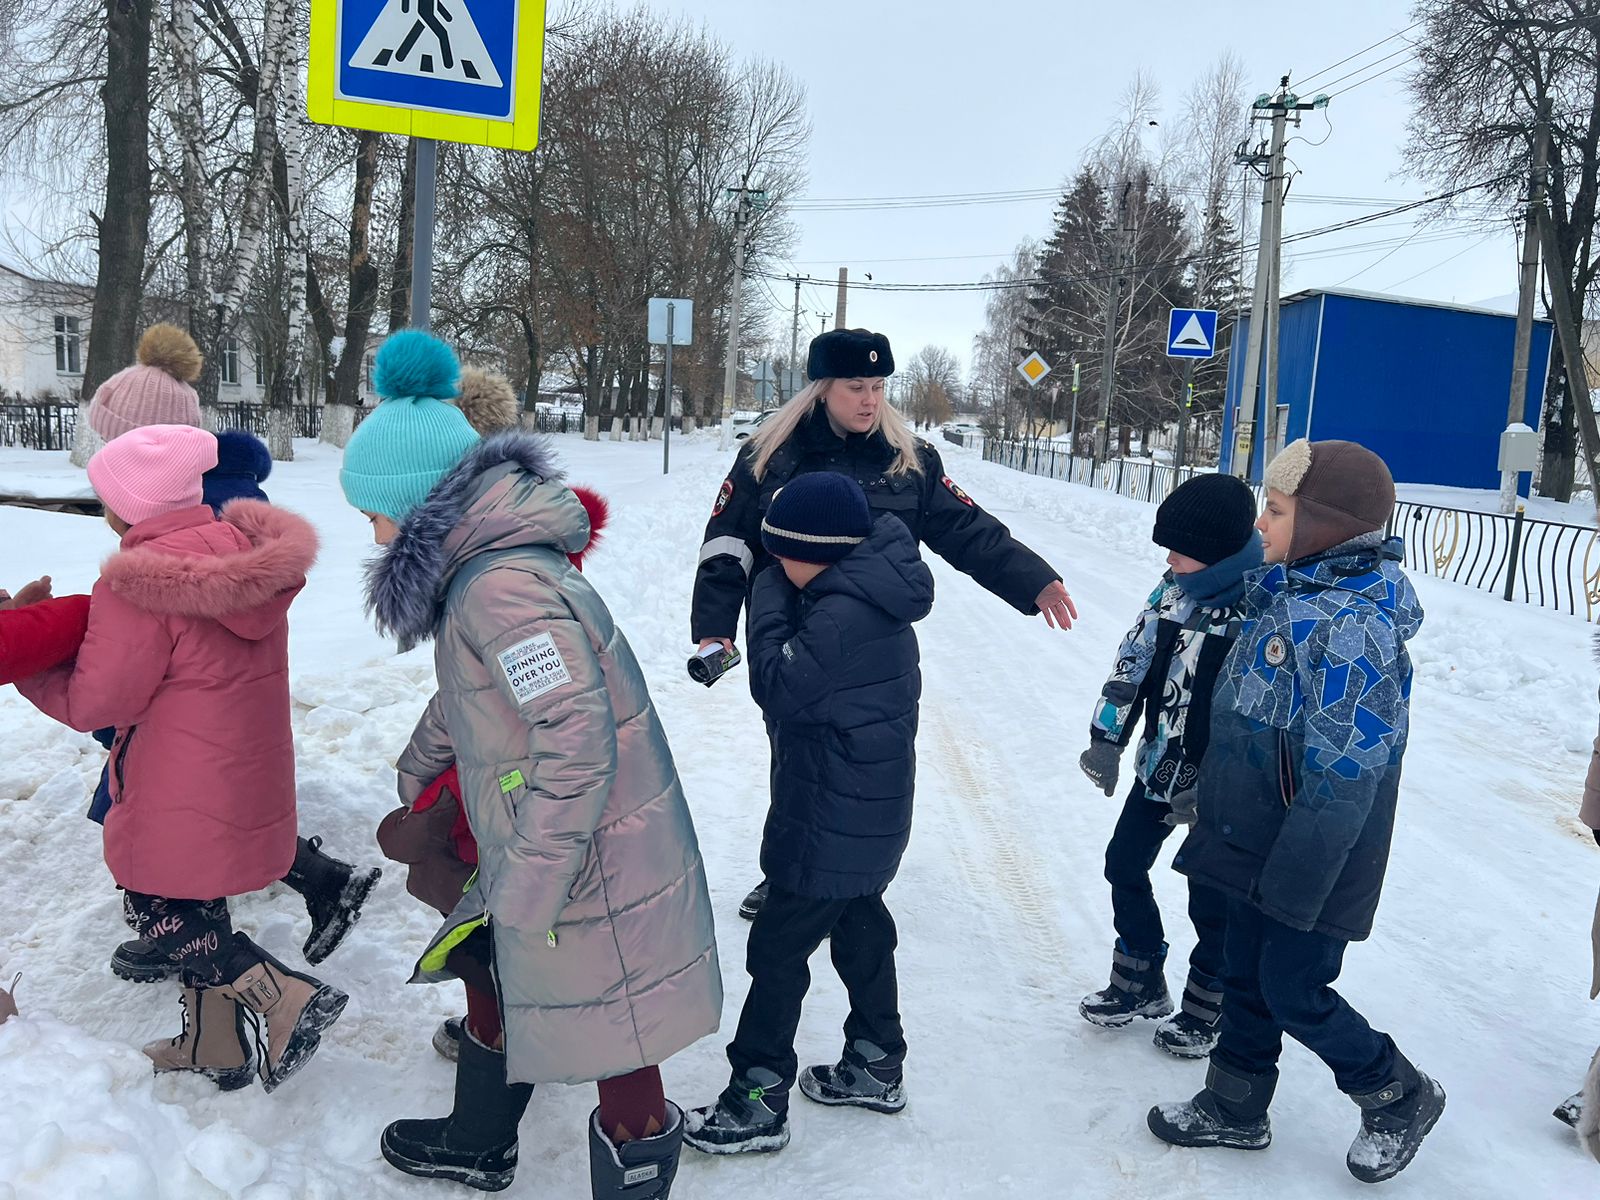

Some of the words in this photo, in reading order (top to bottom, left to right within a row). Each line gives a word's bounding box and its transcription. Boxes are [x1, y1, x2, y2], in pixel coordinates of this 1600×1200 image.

[506, 647, 555, 676] SPINNING
[512, 669, 538, 687] OVER
[538, 658, 561, 674] YOU
